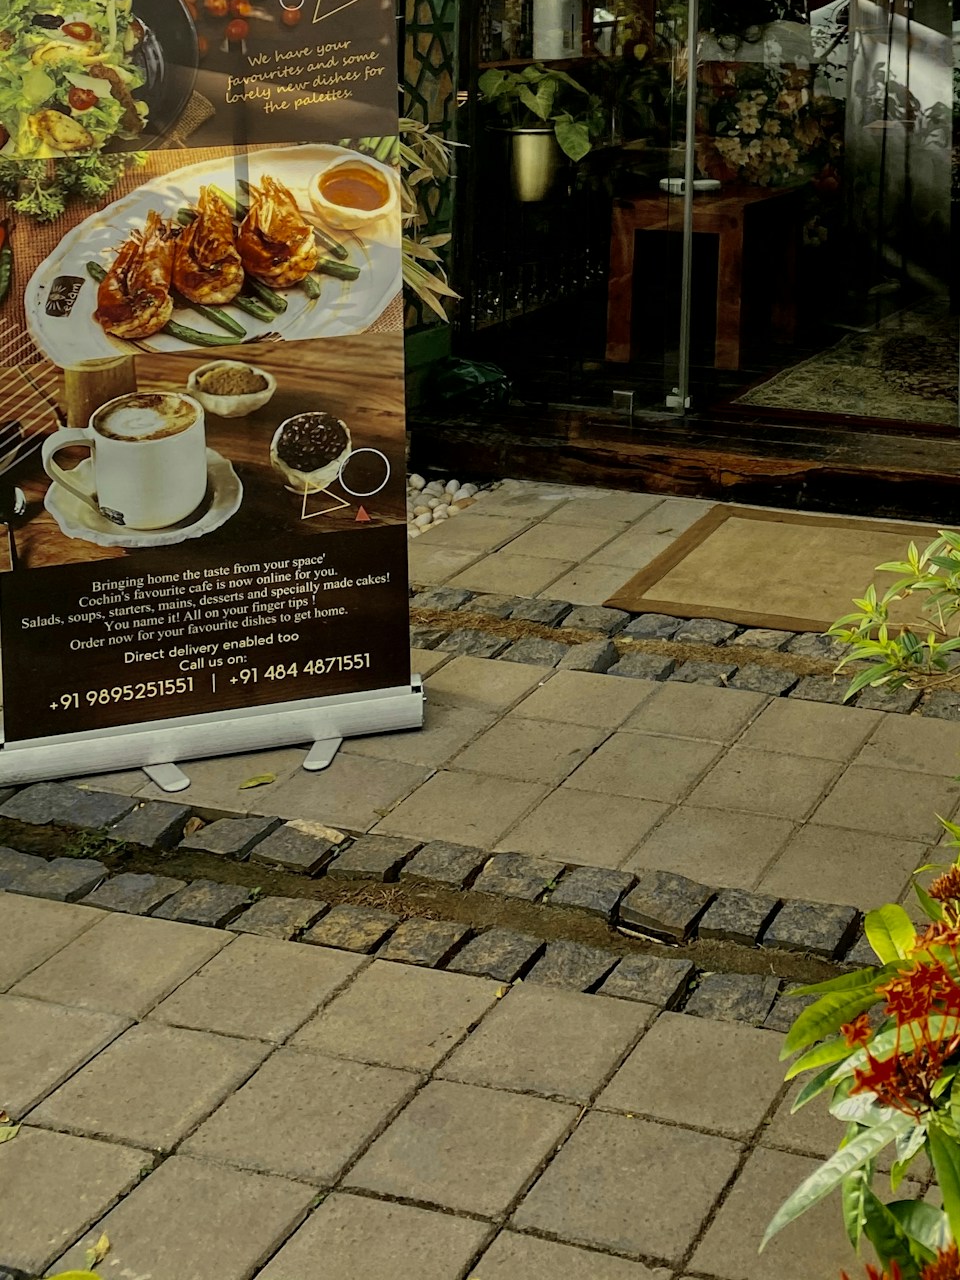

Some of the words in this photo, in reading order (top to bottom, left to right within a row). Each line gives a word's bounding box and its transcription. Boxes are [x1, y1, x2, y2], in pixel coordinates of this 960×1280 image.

[227, 65, 304, 91] favourites
[307, 56, 339, 72] and
[342, 50, 380, 66] some
[247, 52, 271, 67] We
[275, 45, 312, 62] have
[316, 40, 352, 56] your
[225, 86, 272, 104] lovely
[277, 81, 309, 94] new
[312, 70, 361, 88] dishes
[364, 66, 386, 81] for
[264, 100, 290, 114] the
[294, 89, 353, 111] palettes.
[78, 591, 130, 608] Cochin's
[134, 586, 186, 601] favourite
[188, 581, 213, 594] cafe
[216, 578, 226, 590] is
[229, 577, 253, 589] now
[256, 572, 291, 585] online
[295, 569, 311, 580] for
[313, 567, 338, 582] you.
[92, 576, 144, 593] Bringing
[147, 573, 179, 585] home
[182, 570, 200, 581] the
[203, 566, 230, 579] taste
[233, 562, 260, 574] from
[263, 559, 291, 573] your
[21, 614, 65, 630] Salads,
[68, 611, 105, 624] soups,
[108, 603, 155, 618] starters,
[158, 598, 196, 612] mains,
[199, 591, 244, 606] desserts
[247, 587, 268, 600] and
[270, 581, 319, 598] specially
[323, 577, 353, 590] made
[355, 572, 390, 587] cakes!
[104, 620, 130, 632] You
[133, 617, 164, 628] name
[167, 611, 180, 623] it!
[183, 608, 201, 622] All
[204, 610, 219, 619] on
[222, 606, 249, 619] your
[252, 601, 286, 614] finger
[288, 597, 308, 610] tips
[70, 637, 105, 651] Order
[108, 633, 134, 646] now
[137, 629, 154, 641] for
[157, 627, 185, 642] your
[188, 618, 238, 635] favourite
[241, 613, 277, 628] dishes
[280, 612, 291, 622] to
[294, 609, 312, 624] get
[314, 605, 348, 618] home.
[124, 649, 165, 664] Direct
[168, 643, 219, 658] delivery
[222, 633, 274, 651] enabled
[278, 632, 299, 643] too
[179, 657, 204, 671] Call
[208, 658, 223, 668] us
[227, 655, 247, 666] on:
[49, 692, 79, 711] +91
[86, 676, 194, 707] 9895251551
[230, 668, 258, 684] +91
[264, 662, 298, 681] 484
[303, 652, 370, 676] 4871551
